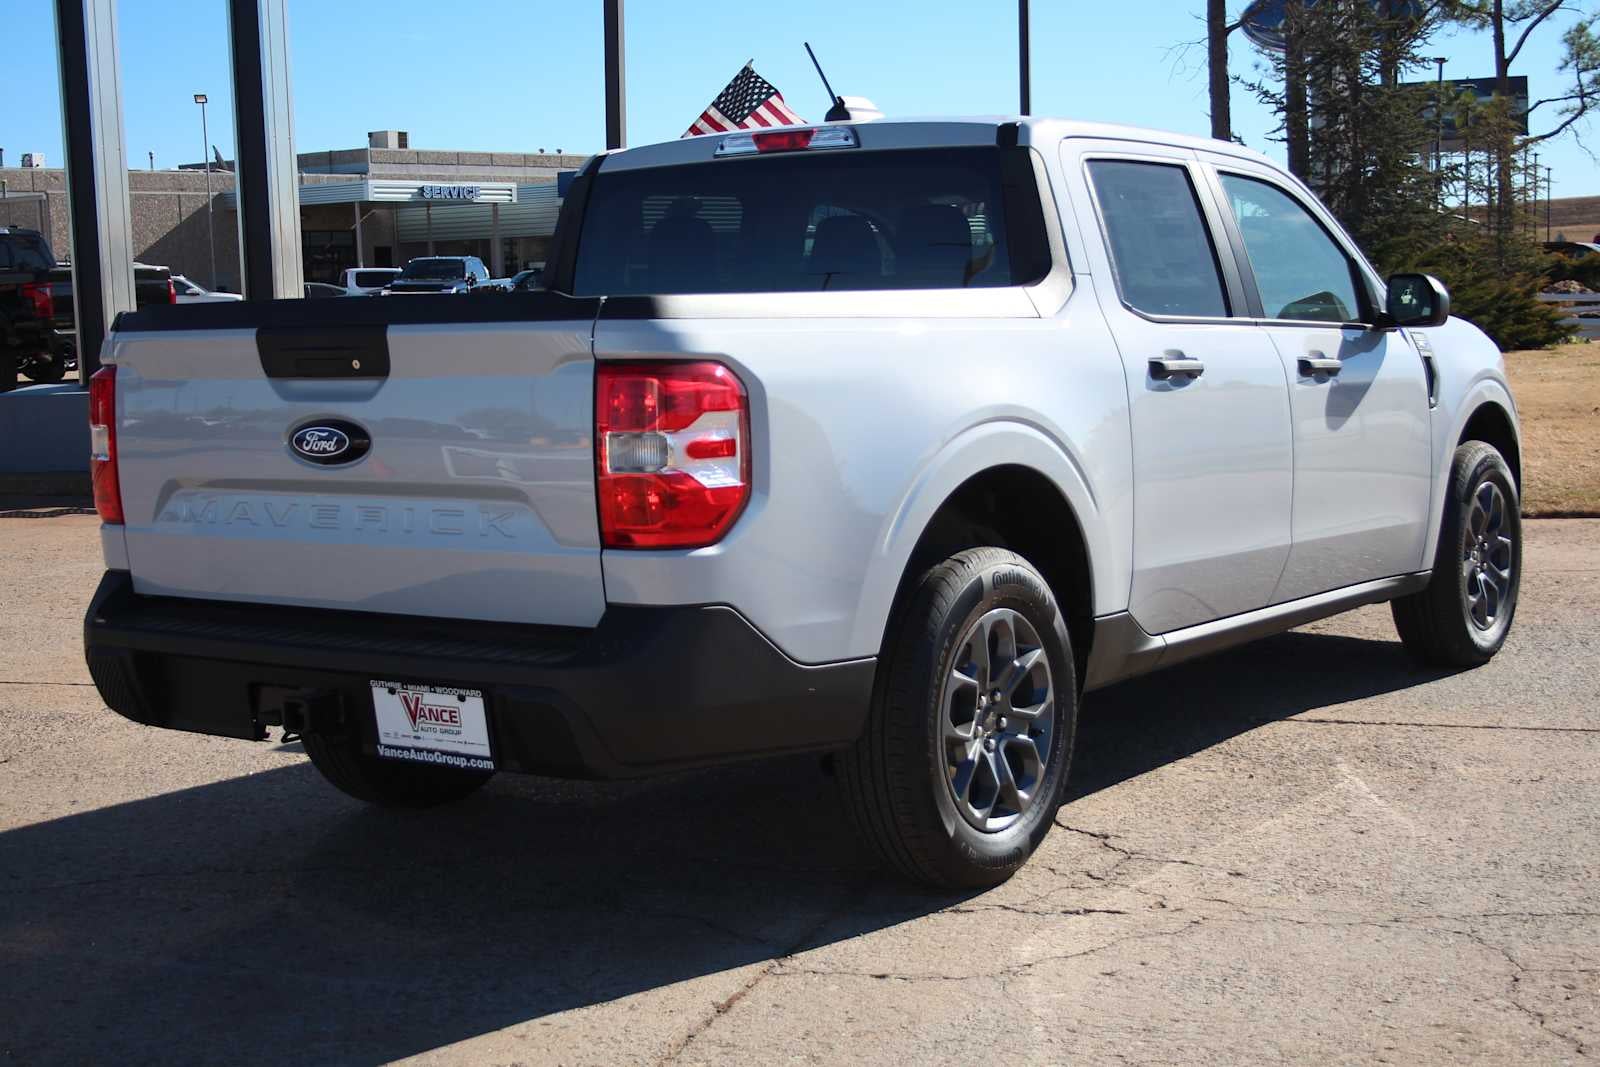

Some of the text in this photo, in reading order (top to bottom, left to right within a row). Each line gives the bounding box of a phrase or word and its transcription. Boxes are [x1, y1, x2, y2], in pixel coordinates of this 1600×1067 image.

[423, 185, 480, 200] SERVICE
[303, 430, 338, 451] Ford
[182, 500, 516, 539] MAVERICK
[434, 686, 482, 698] WOODWARD
[399, 692, 460, 729] VANCE
[420, 726, 462, 736] AUTO GROUP
[377, 745, 494, 769] VanceAutoGroup.com
